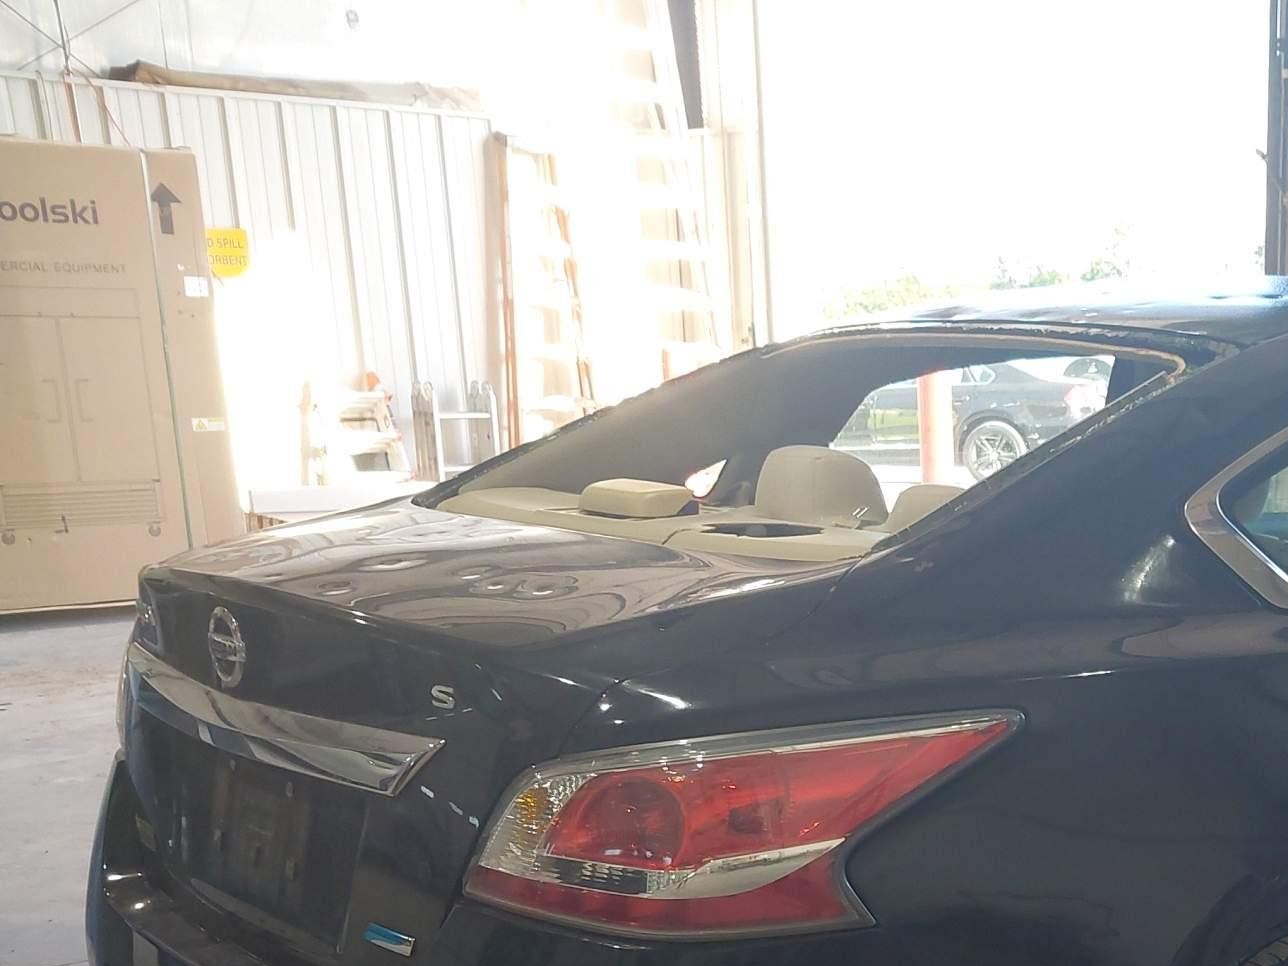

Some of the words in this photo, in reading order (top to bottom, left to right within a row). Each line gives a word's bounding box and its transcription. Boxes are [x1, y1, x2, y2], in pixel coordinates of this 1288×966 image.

[0, 197, 99, 225] oolski
[216, 238, 244, 249] SPILL
[54, 262, 127, 273] EQUIPMENT
[431, 684, 455, 709] S
